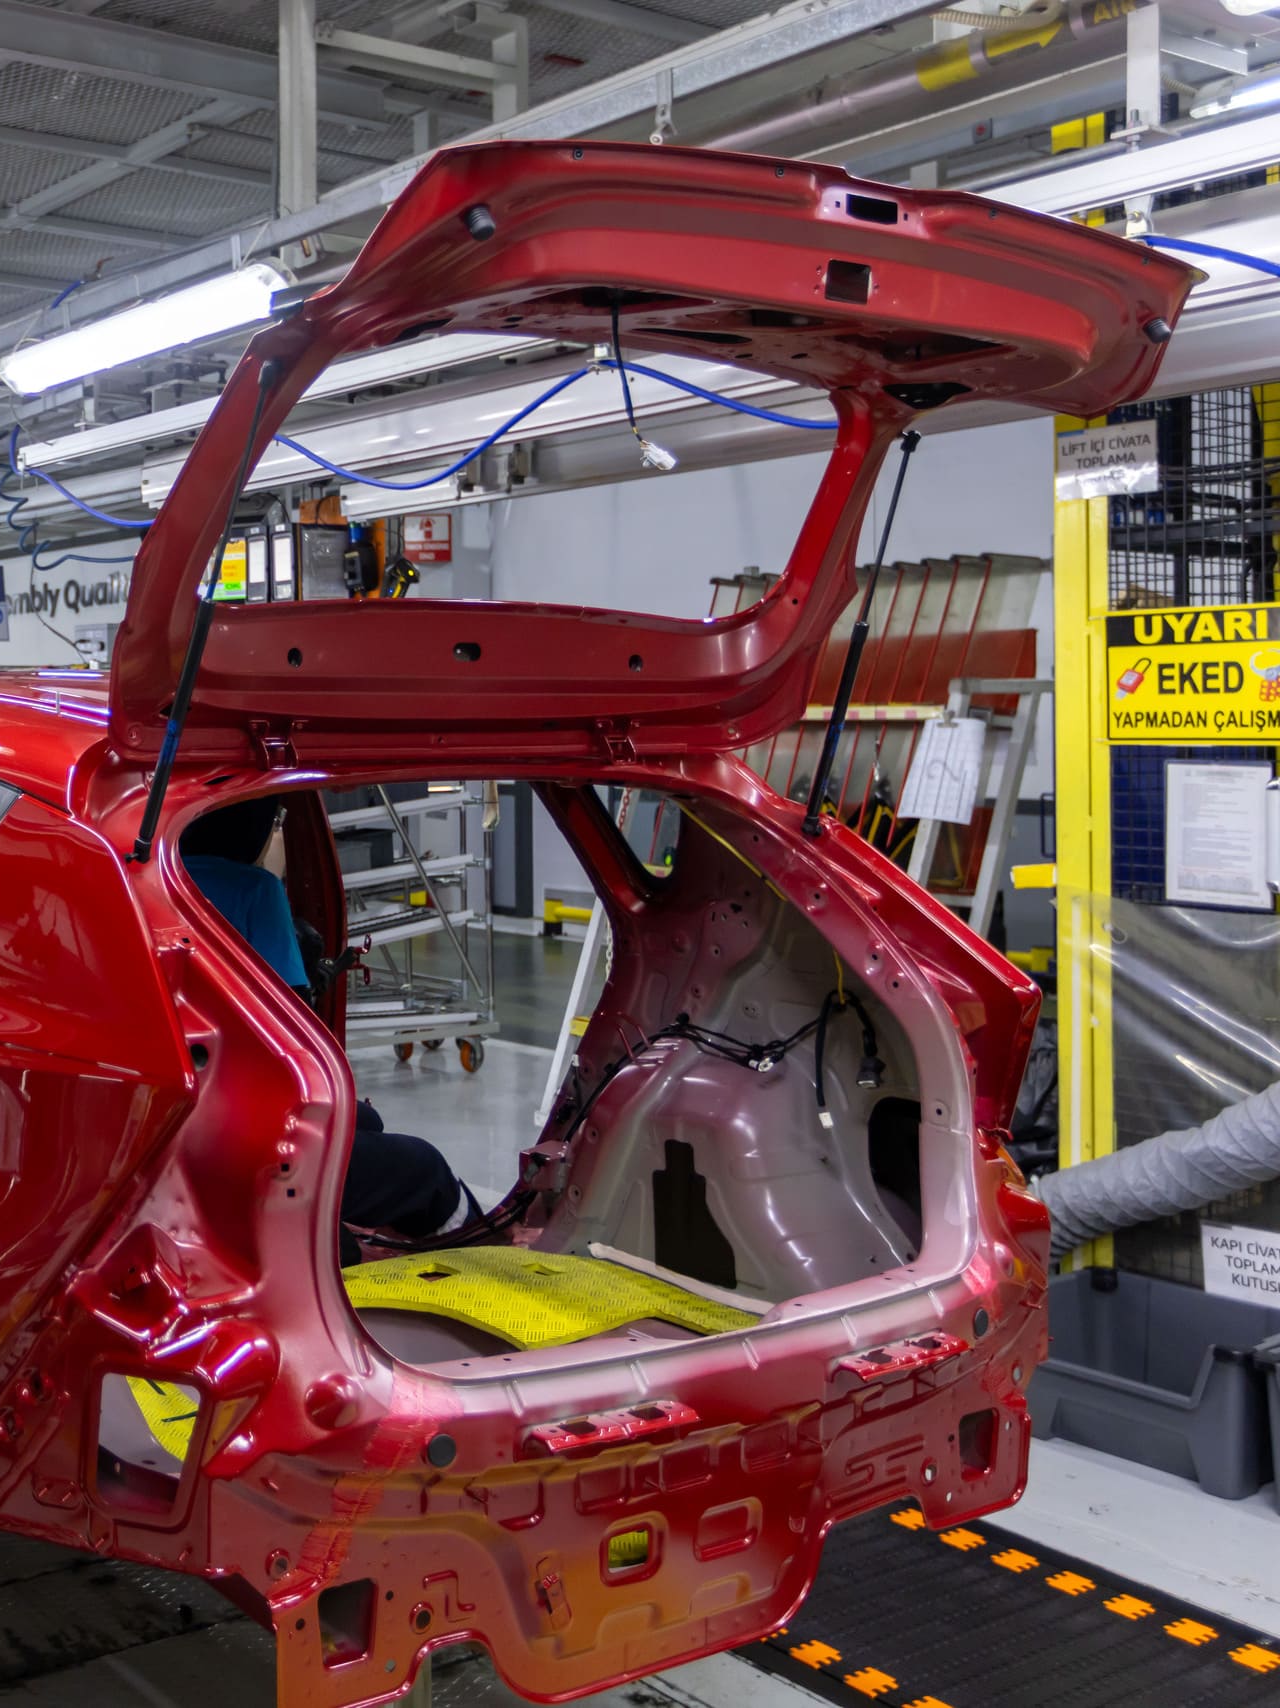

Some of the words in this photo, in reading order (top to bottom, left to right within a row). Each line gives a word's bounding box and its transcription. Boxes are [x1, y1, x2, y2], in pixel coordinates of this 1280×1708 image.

[1061, 441, 1087, 457] LİFT
[1108, 434, 1152, 450] CİVATA
[1076, 451, 1137, 470] TOPLAMA
[1133, 609, 1269, 645] UYARI
[1157, 661, 1245, 695] EKED
[1112, 710, 1208, 729] YAPMADAN
[1213, 709, 1280, 733] ÇALIŞM
[1210, 1235, 1243, 1253] KAPI
[1231, 1272, 1280, 1294] KUTUS
